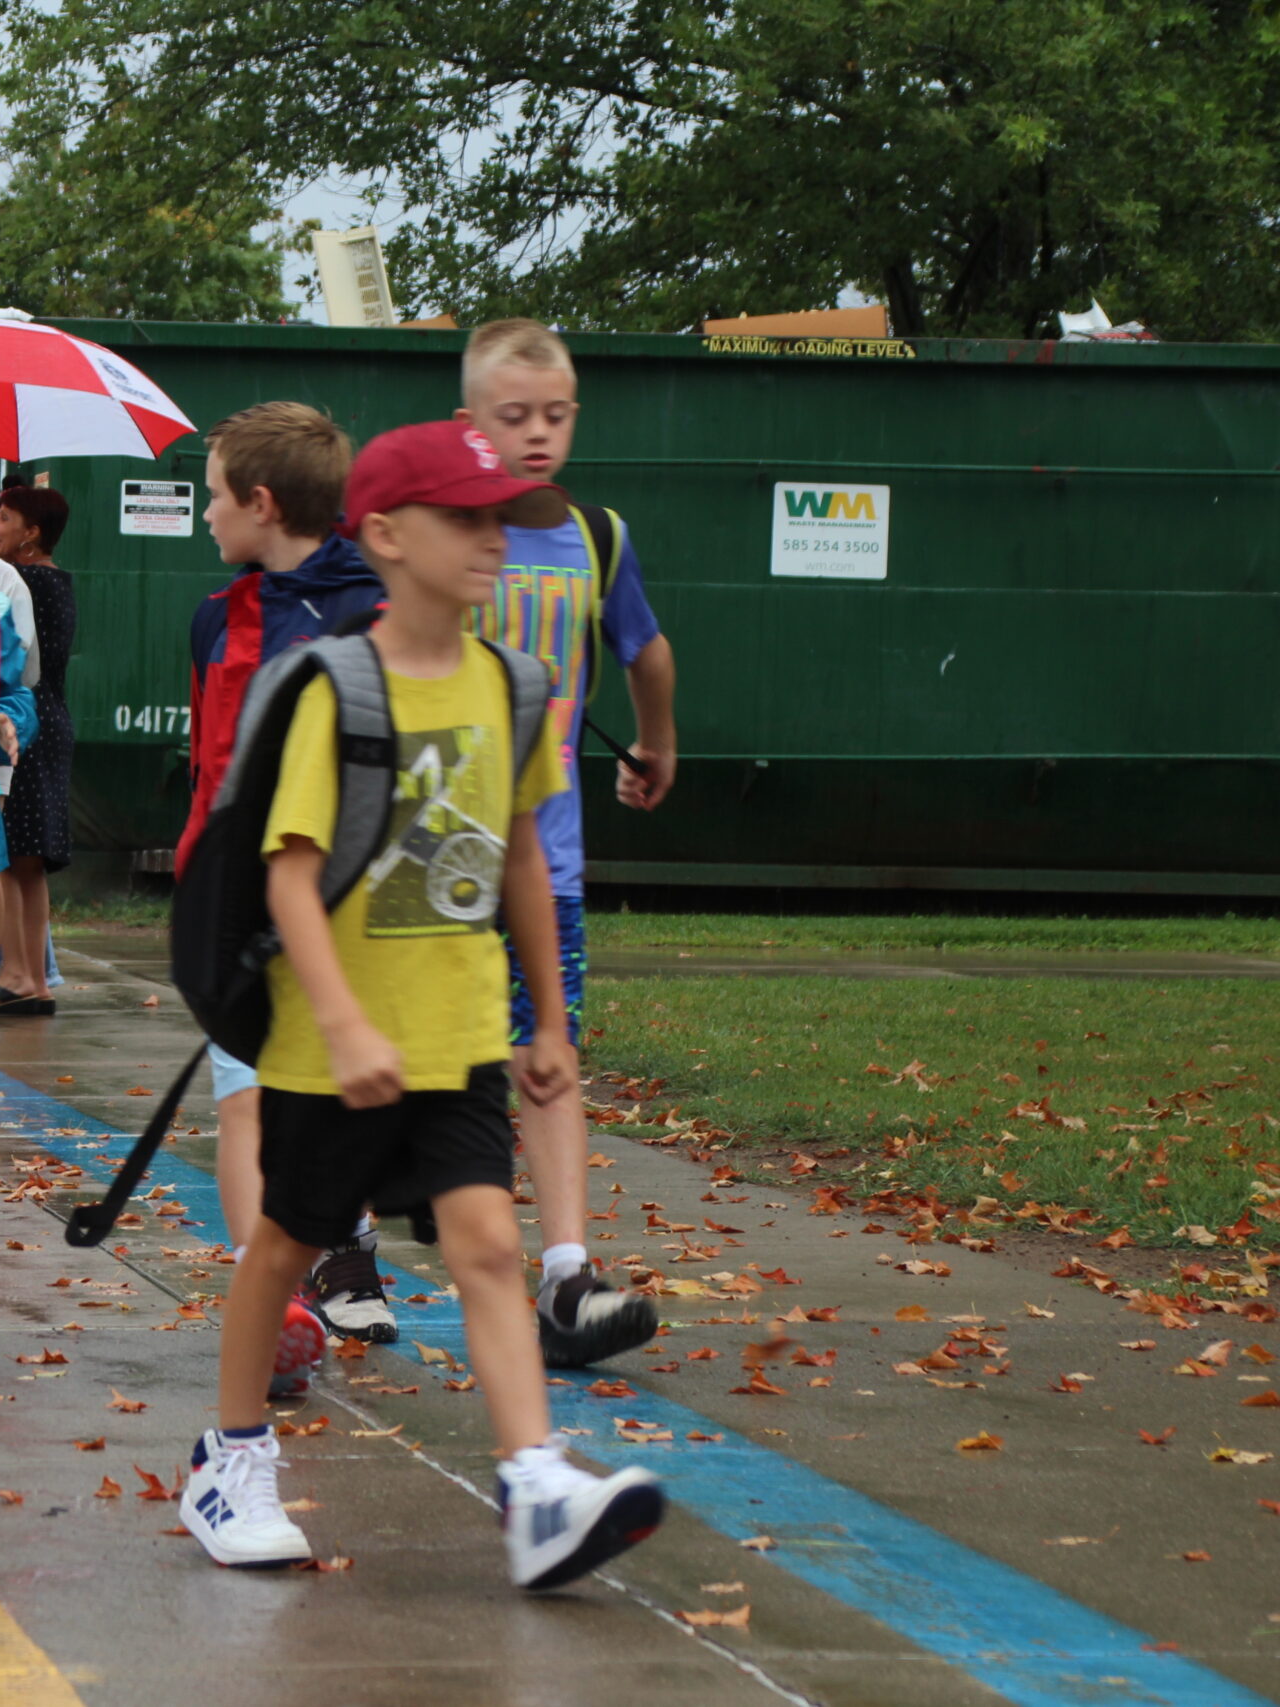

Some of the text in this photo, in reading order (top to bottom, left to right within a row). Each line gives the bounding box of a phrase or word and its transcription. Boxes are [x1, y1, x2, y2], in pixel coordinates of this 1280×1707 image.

[785, 340, 853, 356] LOADING
[140, 483, 176, 491] WARNING
[784, 490, 877, 520] WM
[783, 538, 880, 554] 585 254 3500
